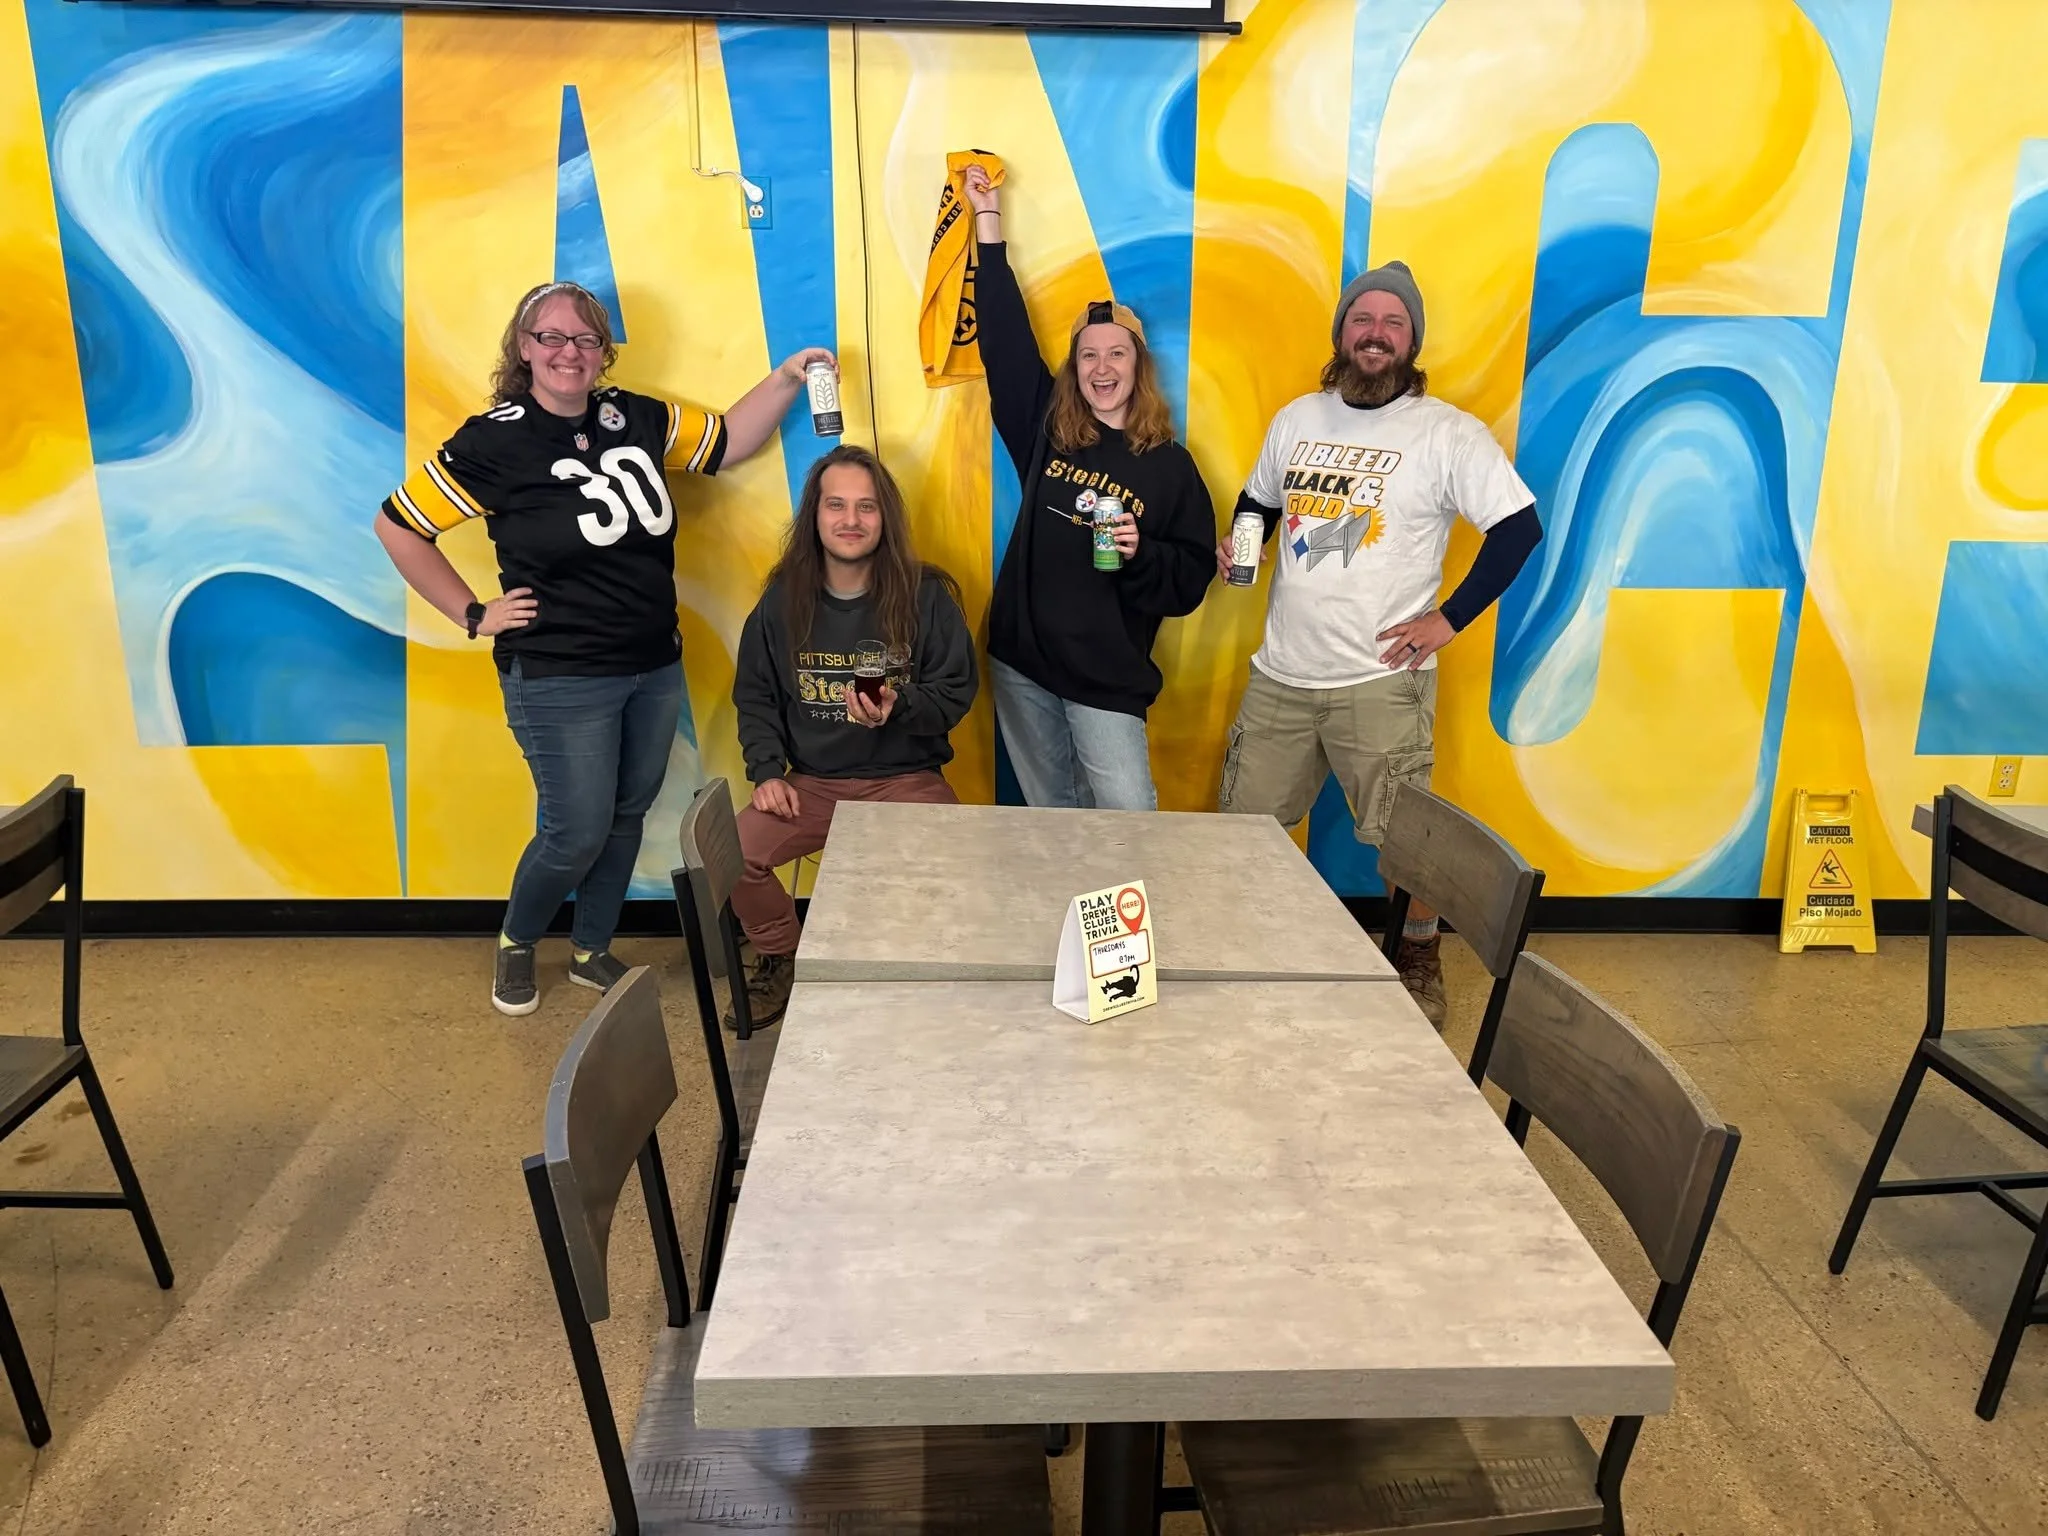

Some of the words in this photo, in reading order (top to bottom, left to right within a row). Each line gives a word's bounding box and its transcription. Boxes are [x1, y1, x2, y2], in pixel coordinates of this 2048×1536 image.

[1290, 442, 1308, 465] I
[1305, 443, 1401, 475] BLEED
[551, 446, 673, 546] 30
[1283, 471, 1356, 496] BLACK
[1350, 476, 1384, 508] &
[1287, 493, 1345, 519] GOLD
[1811, 827, 1848, 835] CAUTION
[1826, 837, 1854, 845] FLOOR
[1080, 893, 1113, 912] PLAY
[1121, 900, 1140, 910] HERE!
[1809, 896, 1852, 905] Cuidado
[1082, 905, 1116, 922] DREW'S
[1800, 908, 1822, 917] Piso
[1825, 907, 1862, 918] Mojado
[1084, 914, 1118, 930] CLUES
[1085, 924, 1119, 940] TRIVIA
